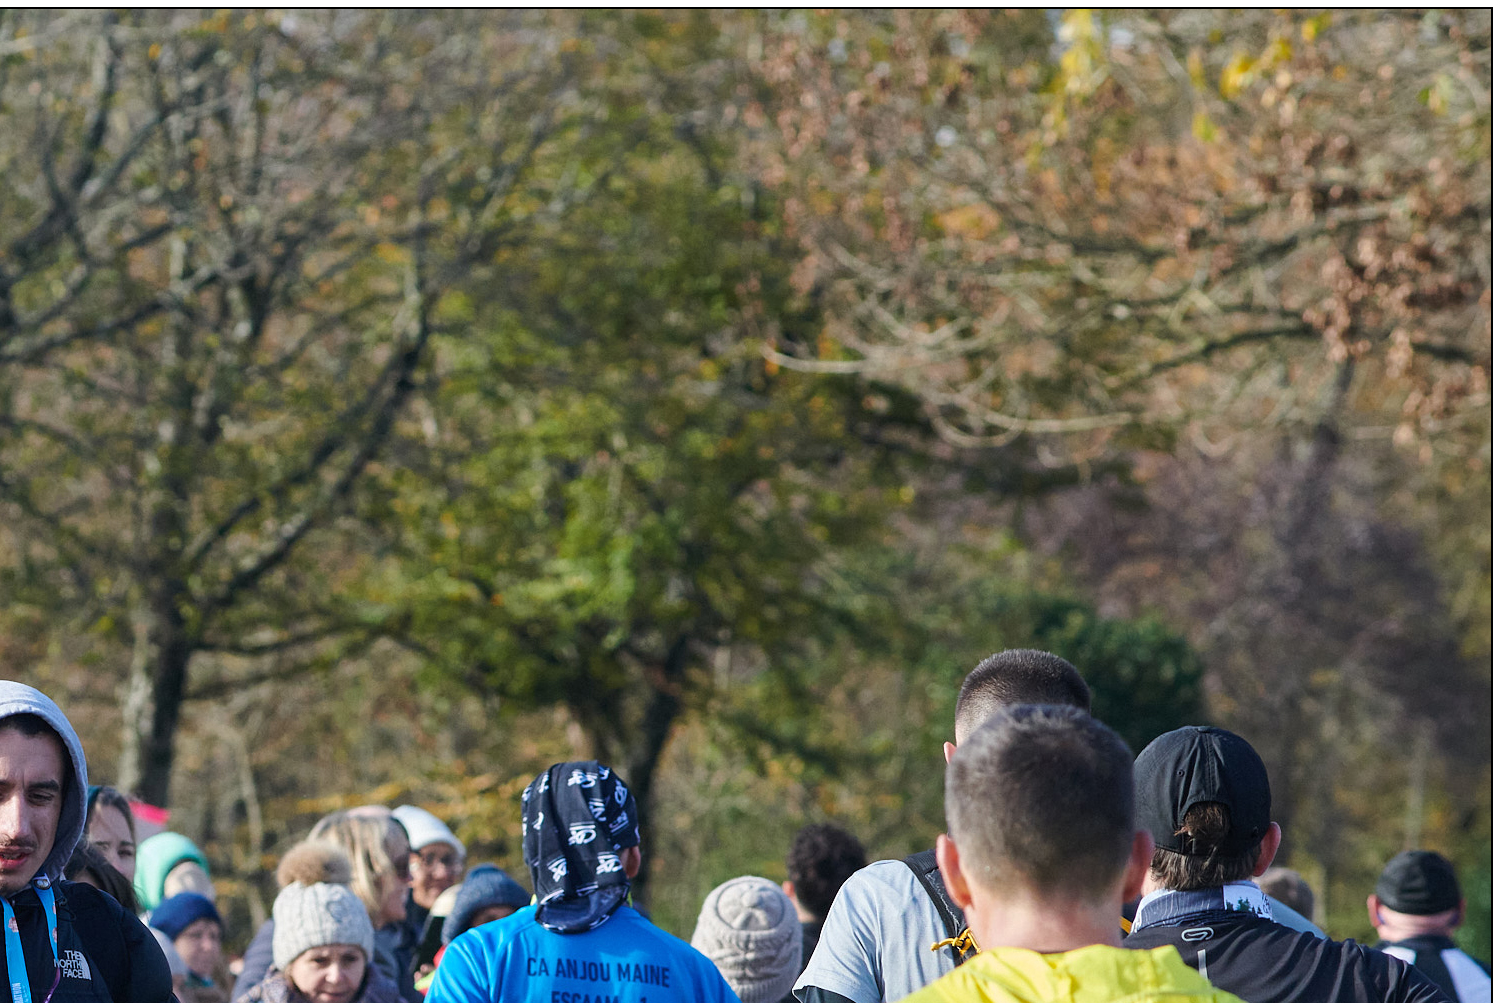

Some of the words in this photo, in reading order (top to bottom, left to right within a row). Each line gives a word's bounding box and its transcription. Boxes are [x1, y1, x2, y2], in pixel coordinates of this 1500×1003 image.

[64, 950, 81, 960] THE
[53, 958, 82, 969] NORTH
[63, 969, 83, 979] FACE
[527, 957, 550, 977] CA
[556, 958, 613, 982] ANJOU
[617, 961, 671, 988] MAINE
